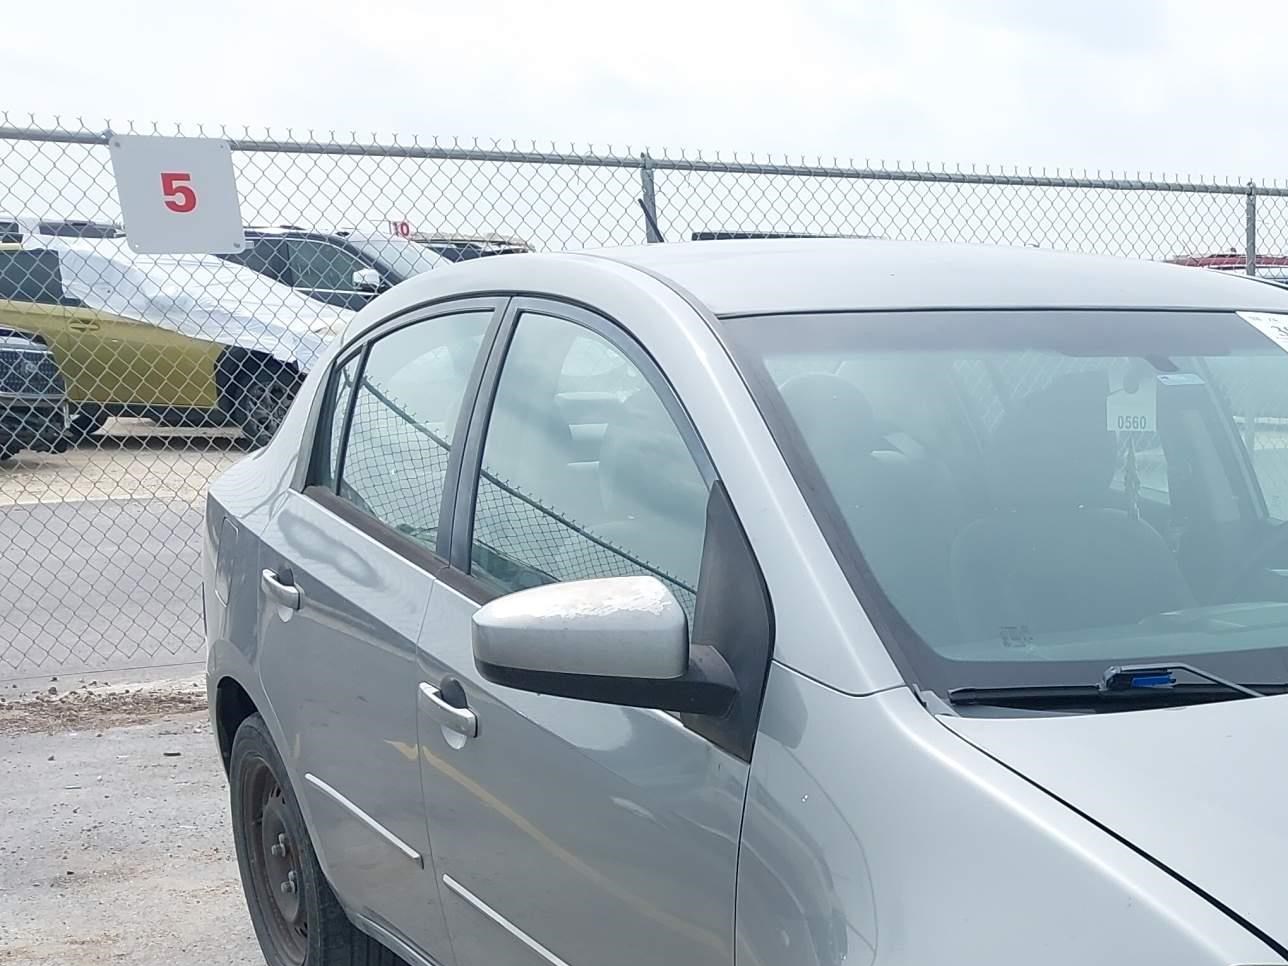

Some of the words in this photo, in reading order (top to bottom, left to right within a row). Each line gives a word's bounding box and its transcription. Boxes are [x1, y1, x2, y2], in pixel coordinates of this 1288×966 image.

[160, 172, 197, 213] 5
[392, 221, 410, 238] 10
[1117, 415, 1147, 430] 0560
